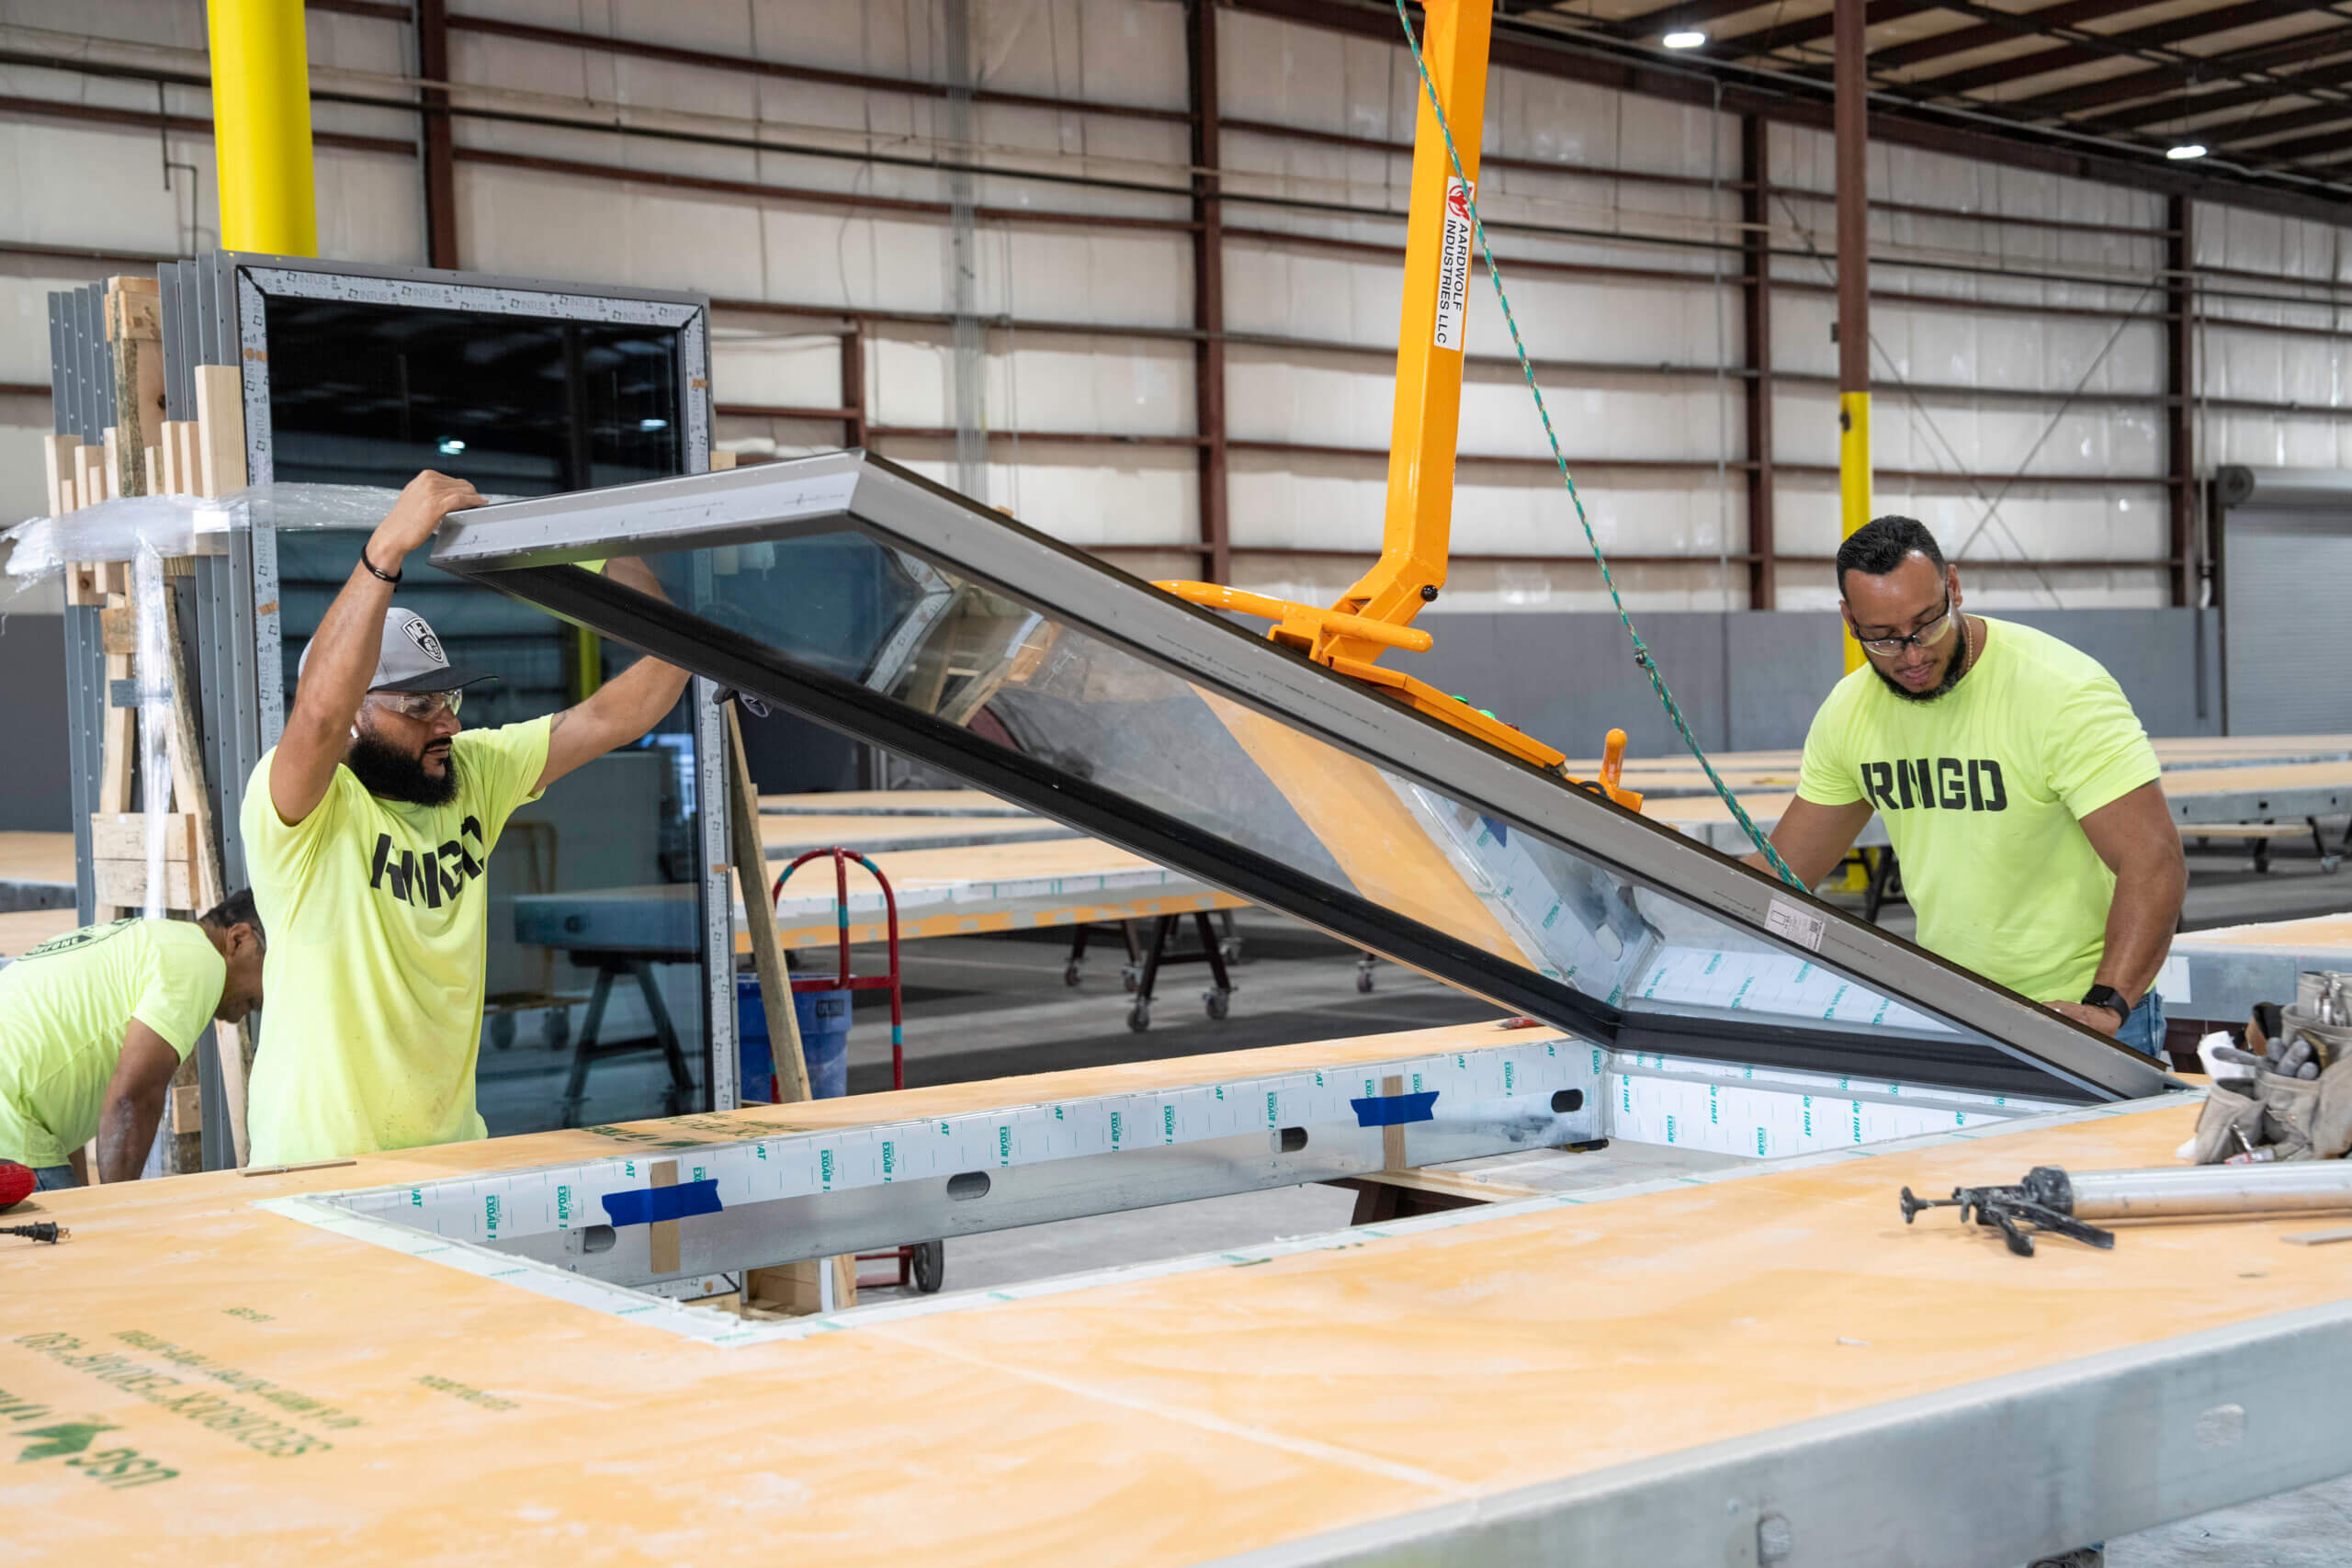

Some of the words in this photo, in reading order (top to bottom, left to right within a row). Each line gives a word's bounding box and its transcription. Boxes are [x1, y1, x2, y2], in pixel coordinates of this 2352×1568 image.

[1440, 219, 1456, 310] INDUSTRIES
[1453, 222, 1468, 311] AARDWOLF
[1437, 315, 1449, 344] LLC
[1860, 757, 2007, 811] RNGD
